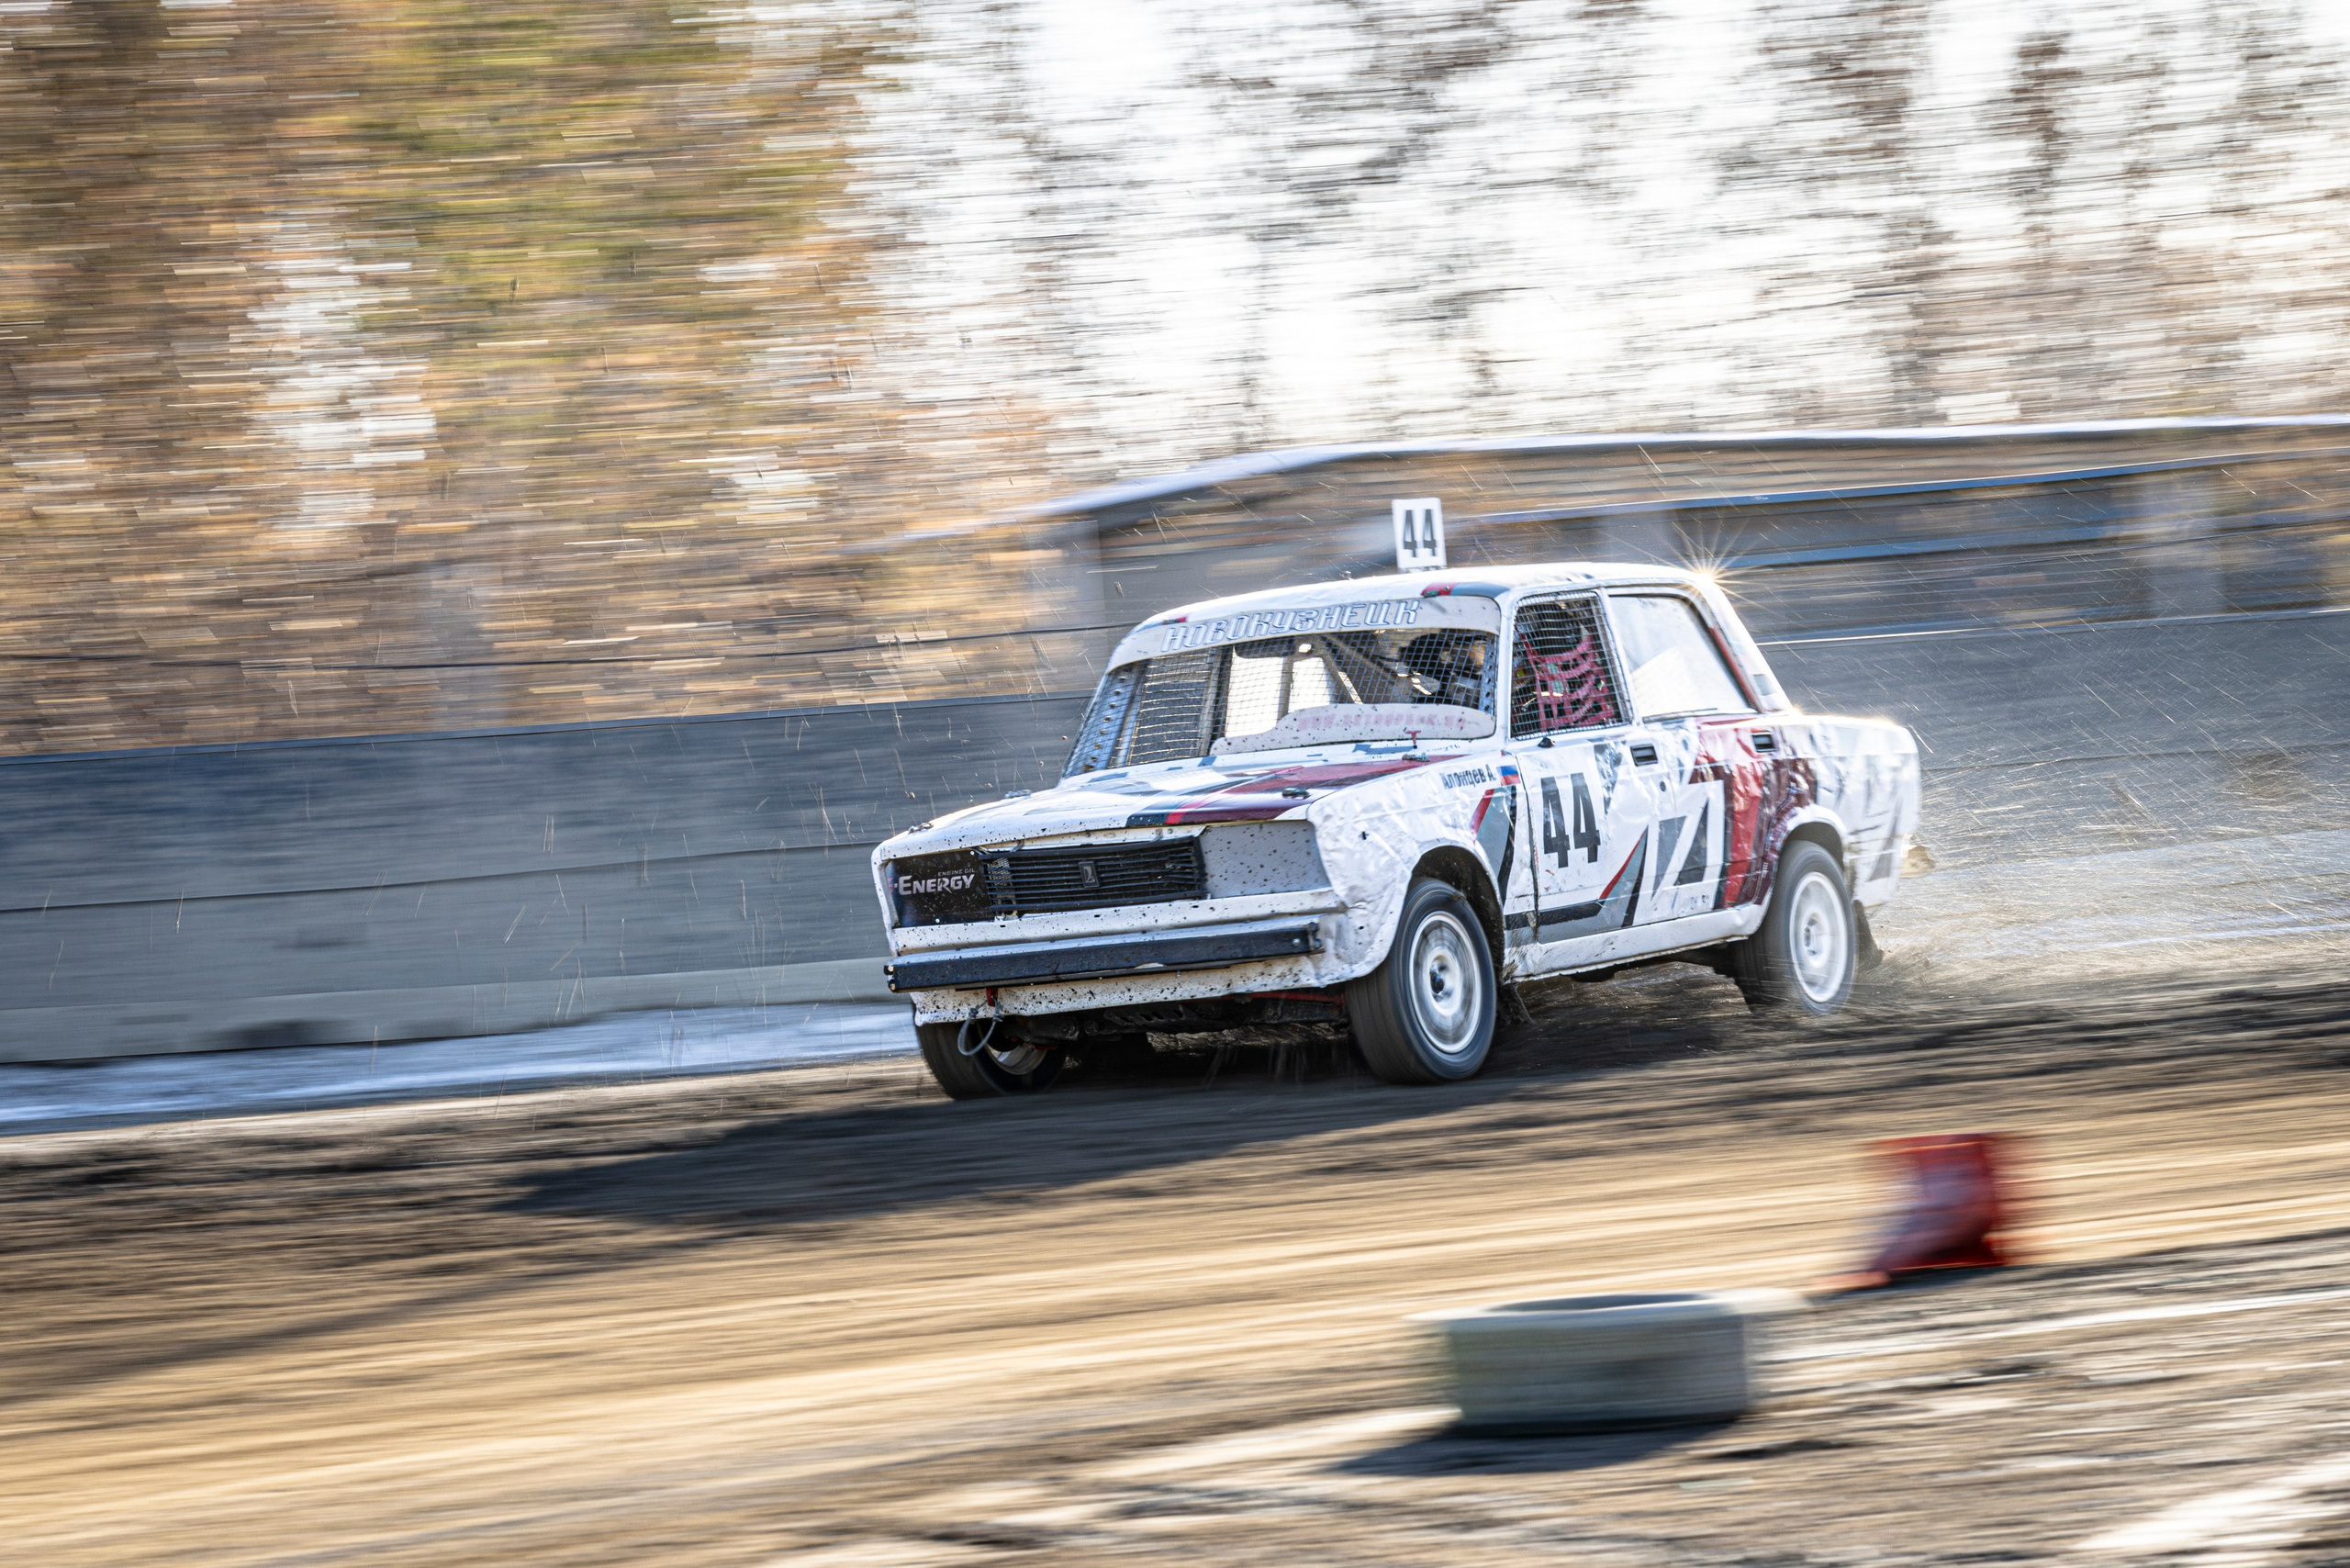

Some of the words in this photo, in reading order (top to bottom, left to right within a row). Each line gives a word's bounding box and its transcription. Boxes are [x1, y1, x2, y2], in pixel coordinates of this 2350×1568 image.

[1403, 509, 1438, 558] 44
[1160, 599, 1422, 653] НОВОКУЗНЕЦК
[1540, 772, 1601, 868] 44
[937, 868, 963, 878] ENGINE
